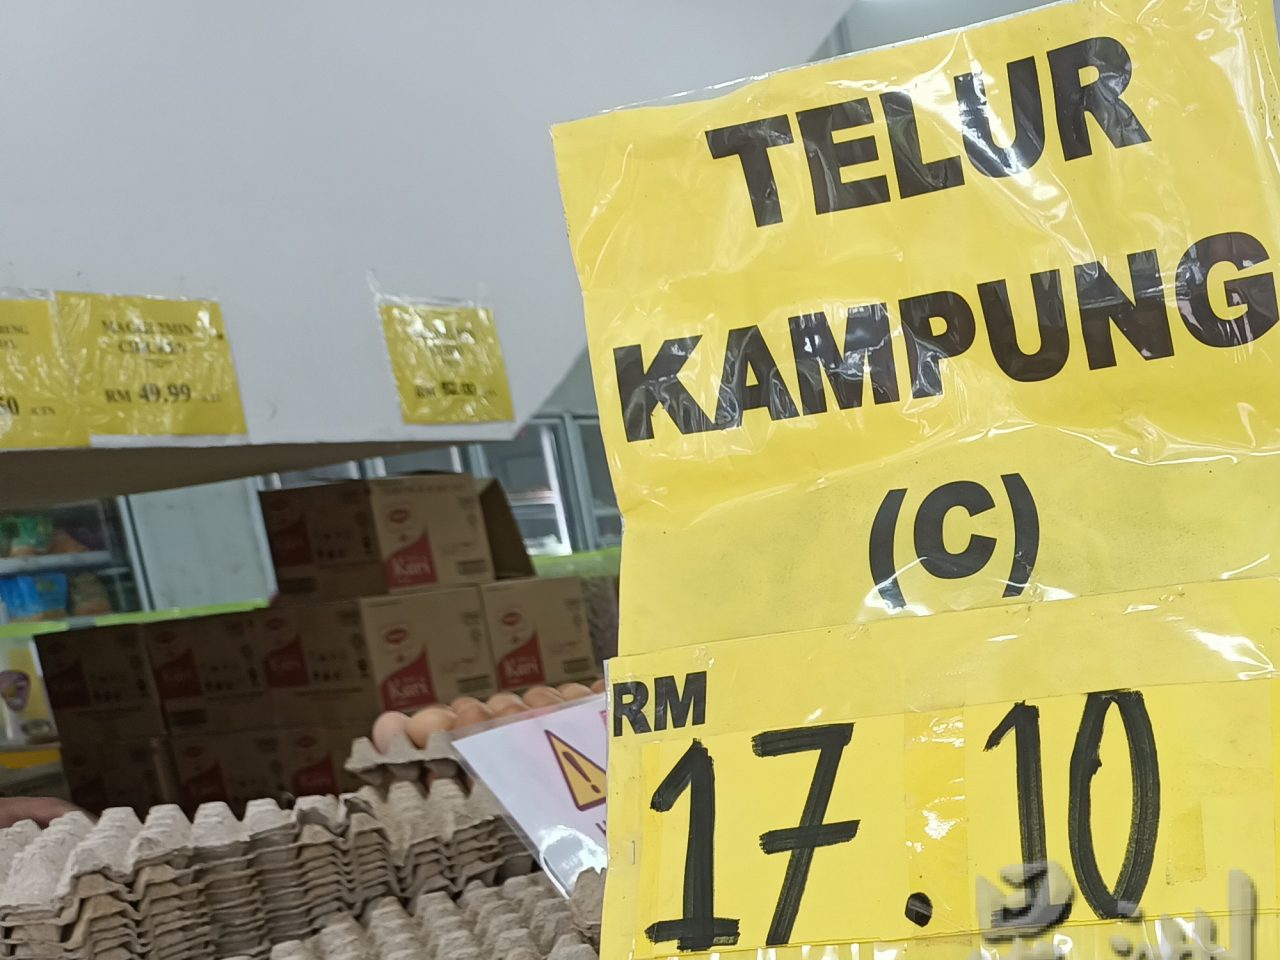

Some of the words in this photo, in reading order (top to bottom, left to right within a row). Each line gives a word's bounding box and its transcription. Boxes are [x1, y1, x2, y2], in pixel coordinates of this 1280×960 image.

[705, 36, 1153, 228] TELUR
[105, 388, 132, 403] RM
[139, 383, 191, 403] 49.99
[613, 232, 1280, 442] KAMPUNG
[868, 473, 1040, 609] (C)
[612, 671, 708, 737] RM
[644, 688, 1161, 952] 17.10
